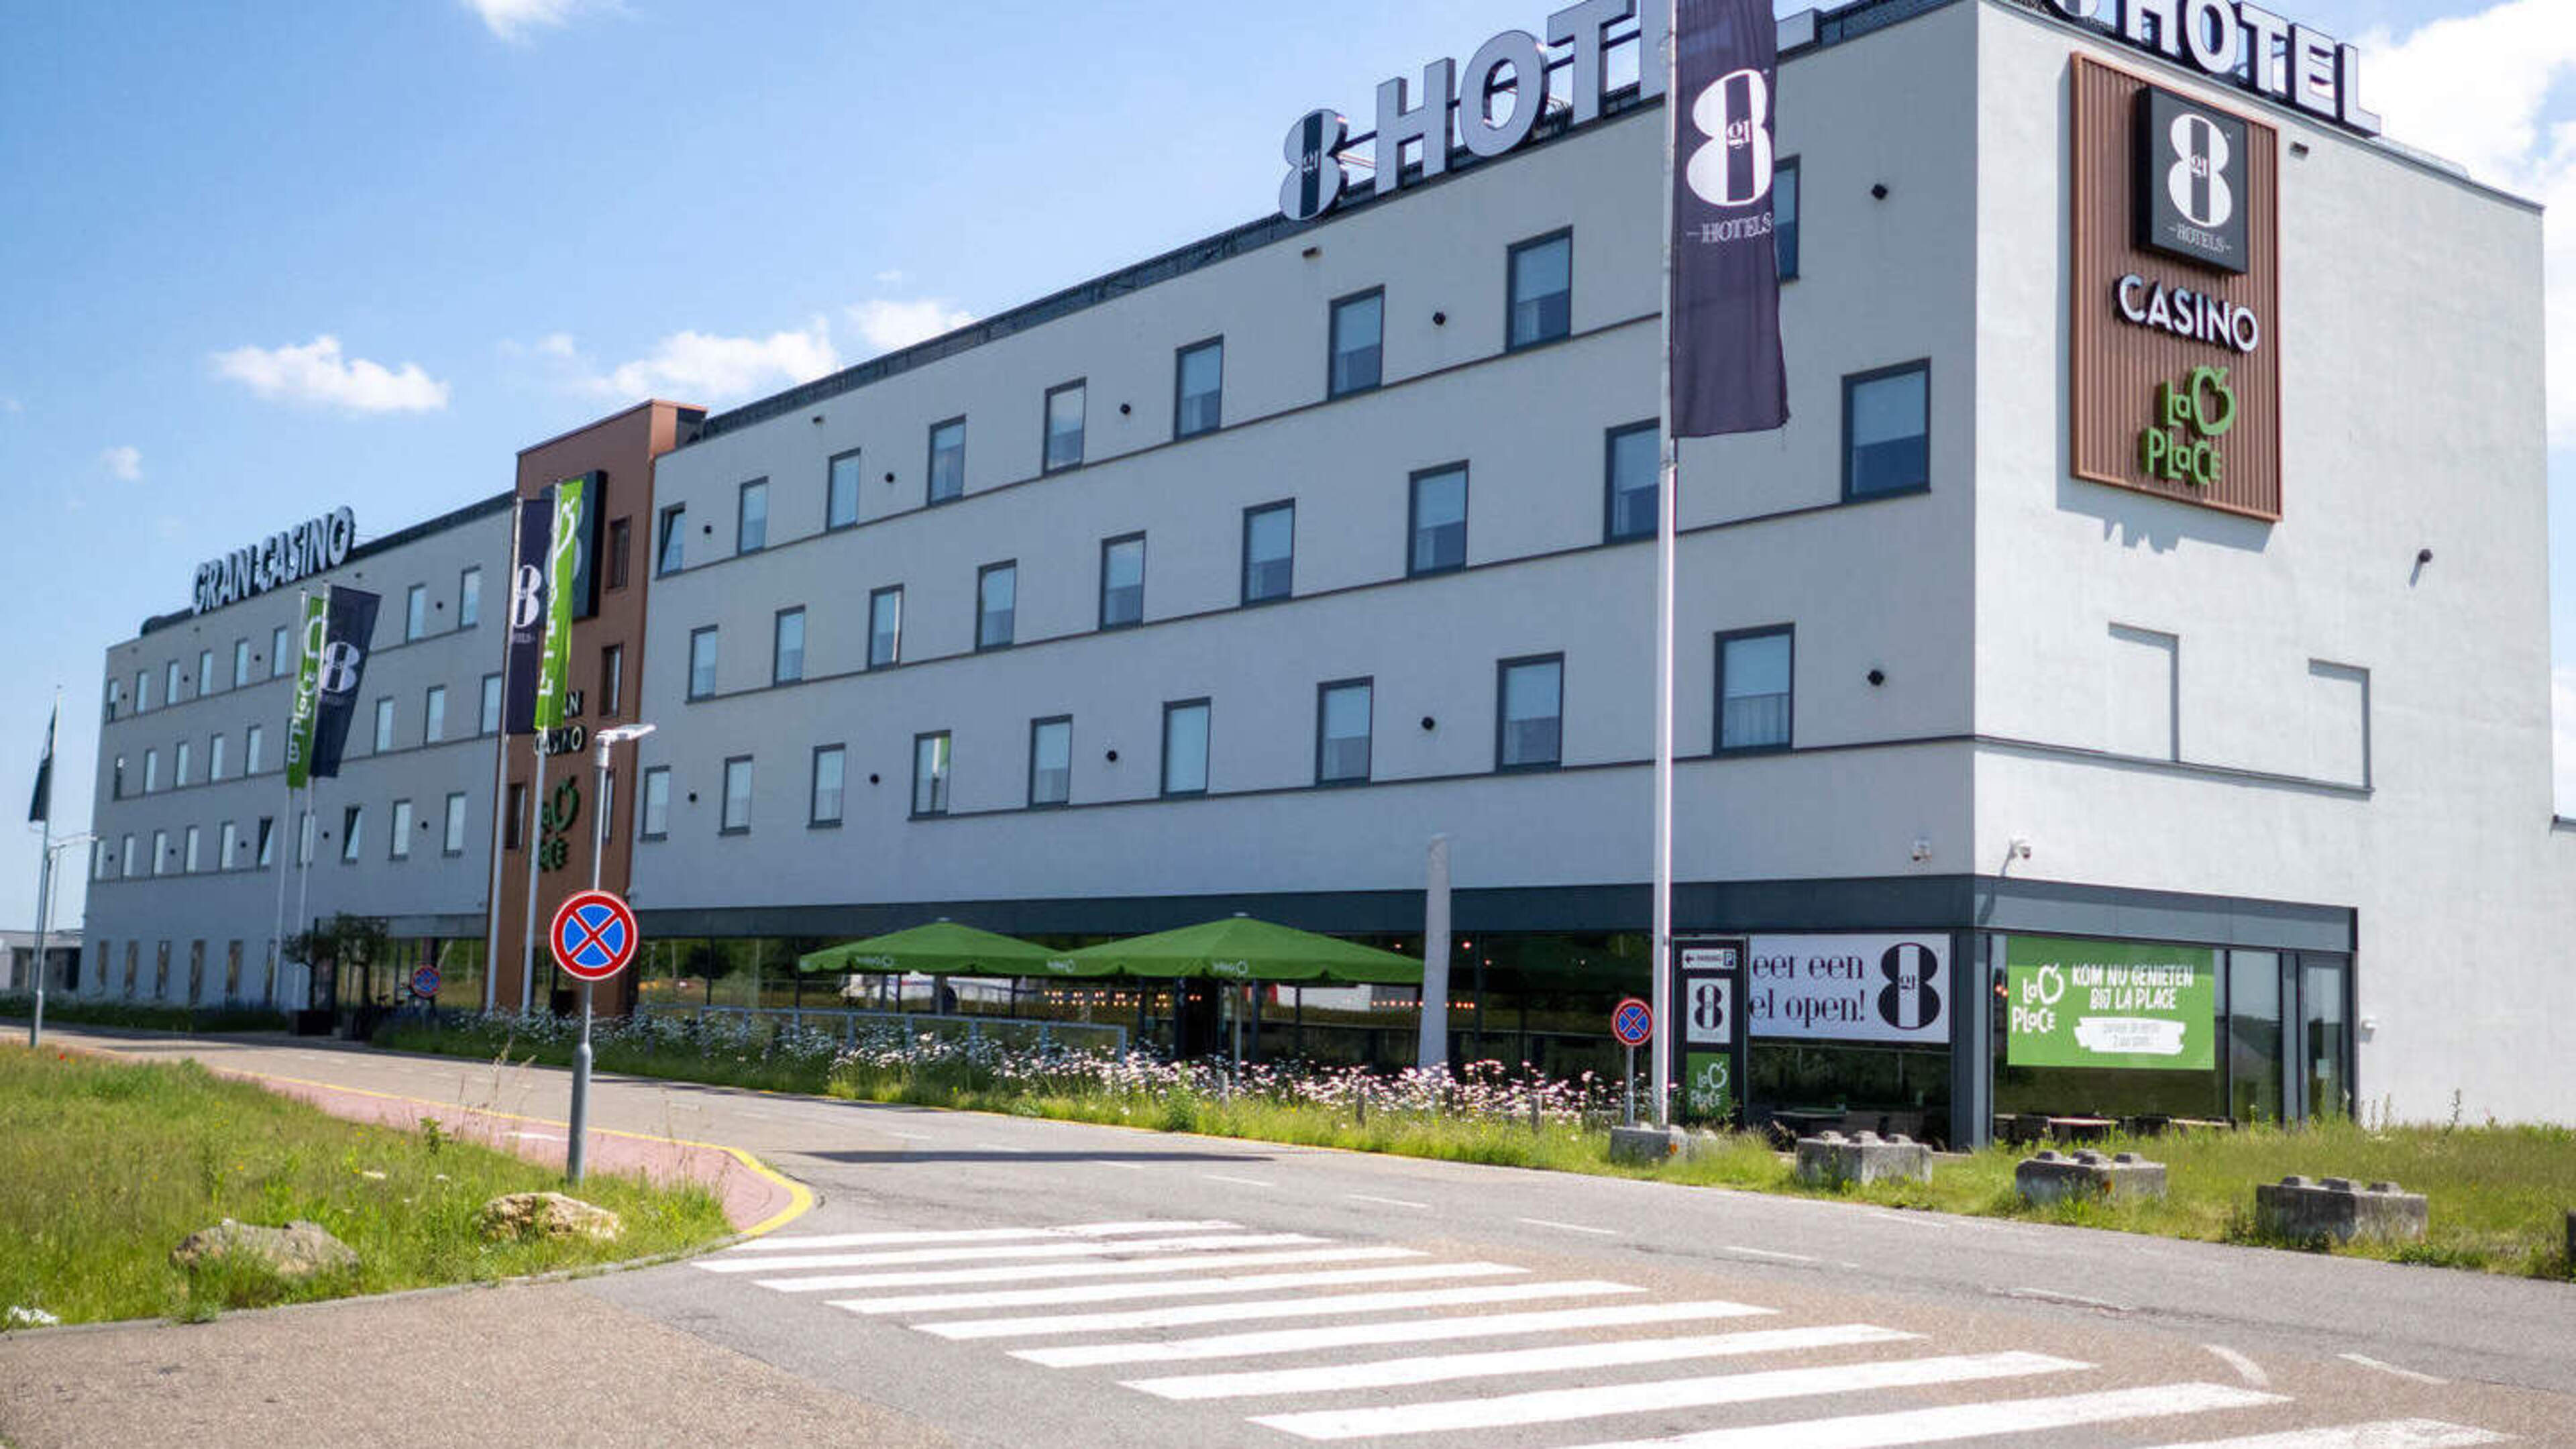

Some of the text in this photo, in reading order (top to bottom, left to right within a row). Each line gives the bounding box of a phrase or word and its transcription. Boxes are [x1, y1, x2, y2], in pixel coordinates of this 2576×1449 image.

[2117, 0, 2381, 138] HOTEL
[1279, 109, 1347, 220] 8
[1686, 69, 1772, 207] 8
[2168, 113, 2233, 227] 8
[2116, 274, 2259, 353] CASINO
[192, 506, 355, 615] GRAN CASINO
[1695, 984, 1723, 1030] 8
[1753, 955, 1863, 979] eer een
[1878, 942, 1941, 1030] 8
[2072, 964, 2194, 987] KOM NU GENIETEN
[2115, 987, 2132, 1010] LA
[2135, 987, 2177, 1010] PLACE
[1785, 989, 1865, 1029] open!
